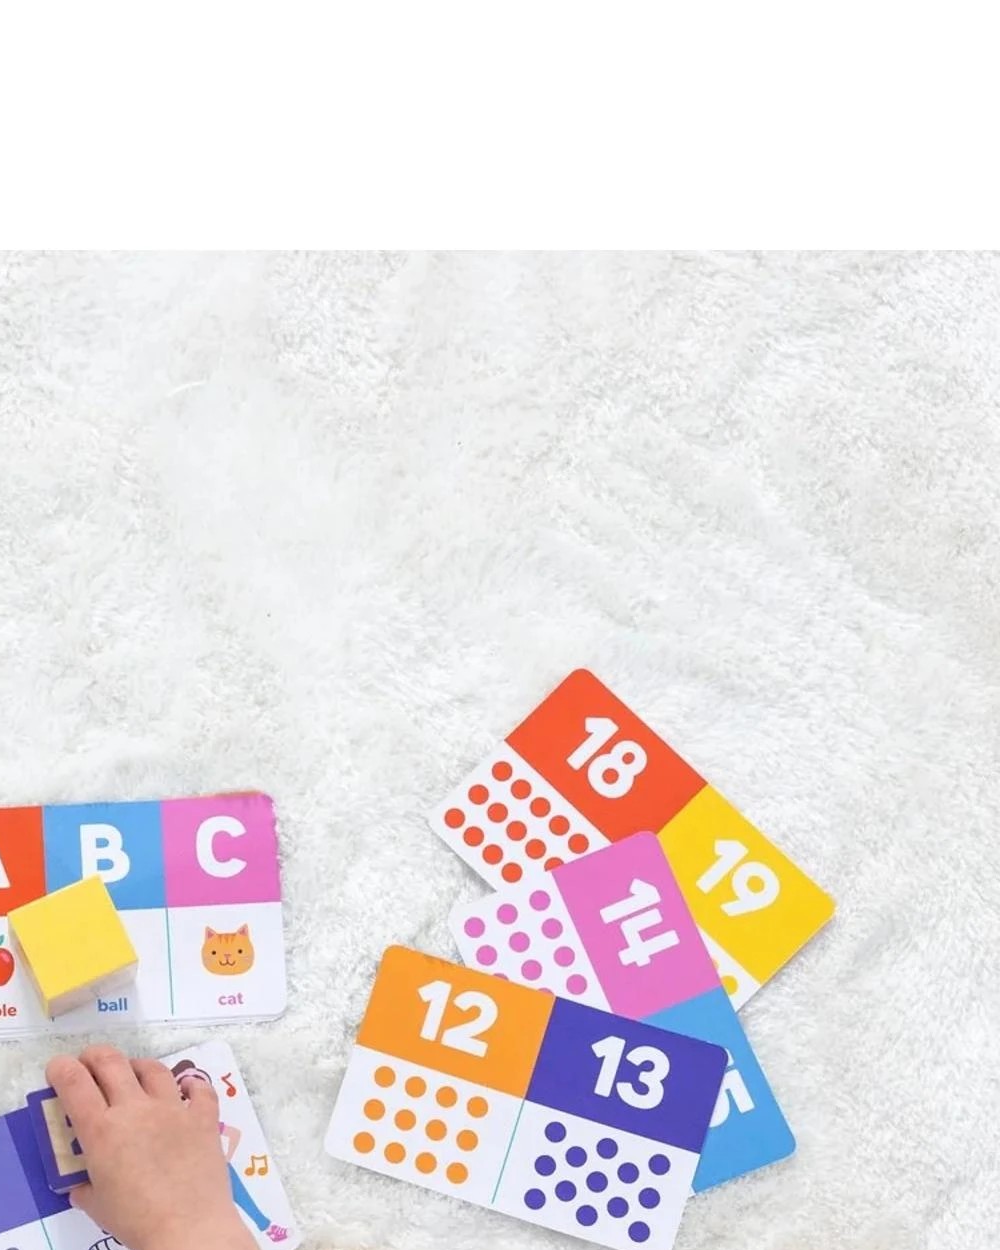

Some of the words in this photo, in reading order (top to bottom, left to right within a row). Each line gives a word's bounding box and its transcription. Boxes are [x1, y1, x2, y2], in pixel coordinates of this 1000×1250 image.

[566, 716, 648, 799] 18
[79, 823, 131, 884] B
[195, 815, 248, 879] C
[696, 839, 780, 917] 19
[599, 878, 680, 967] 14
[97, 997, 129, 1012] ball
[217, 991, 245, 1006] cat
[417, 980, 498, 1059] 12
[590, 1035, 671, 1110] 13
